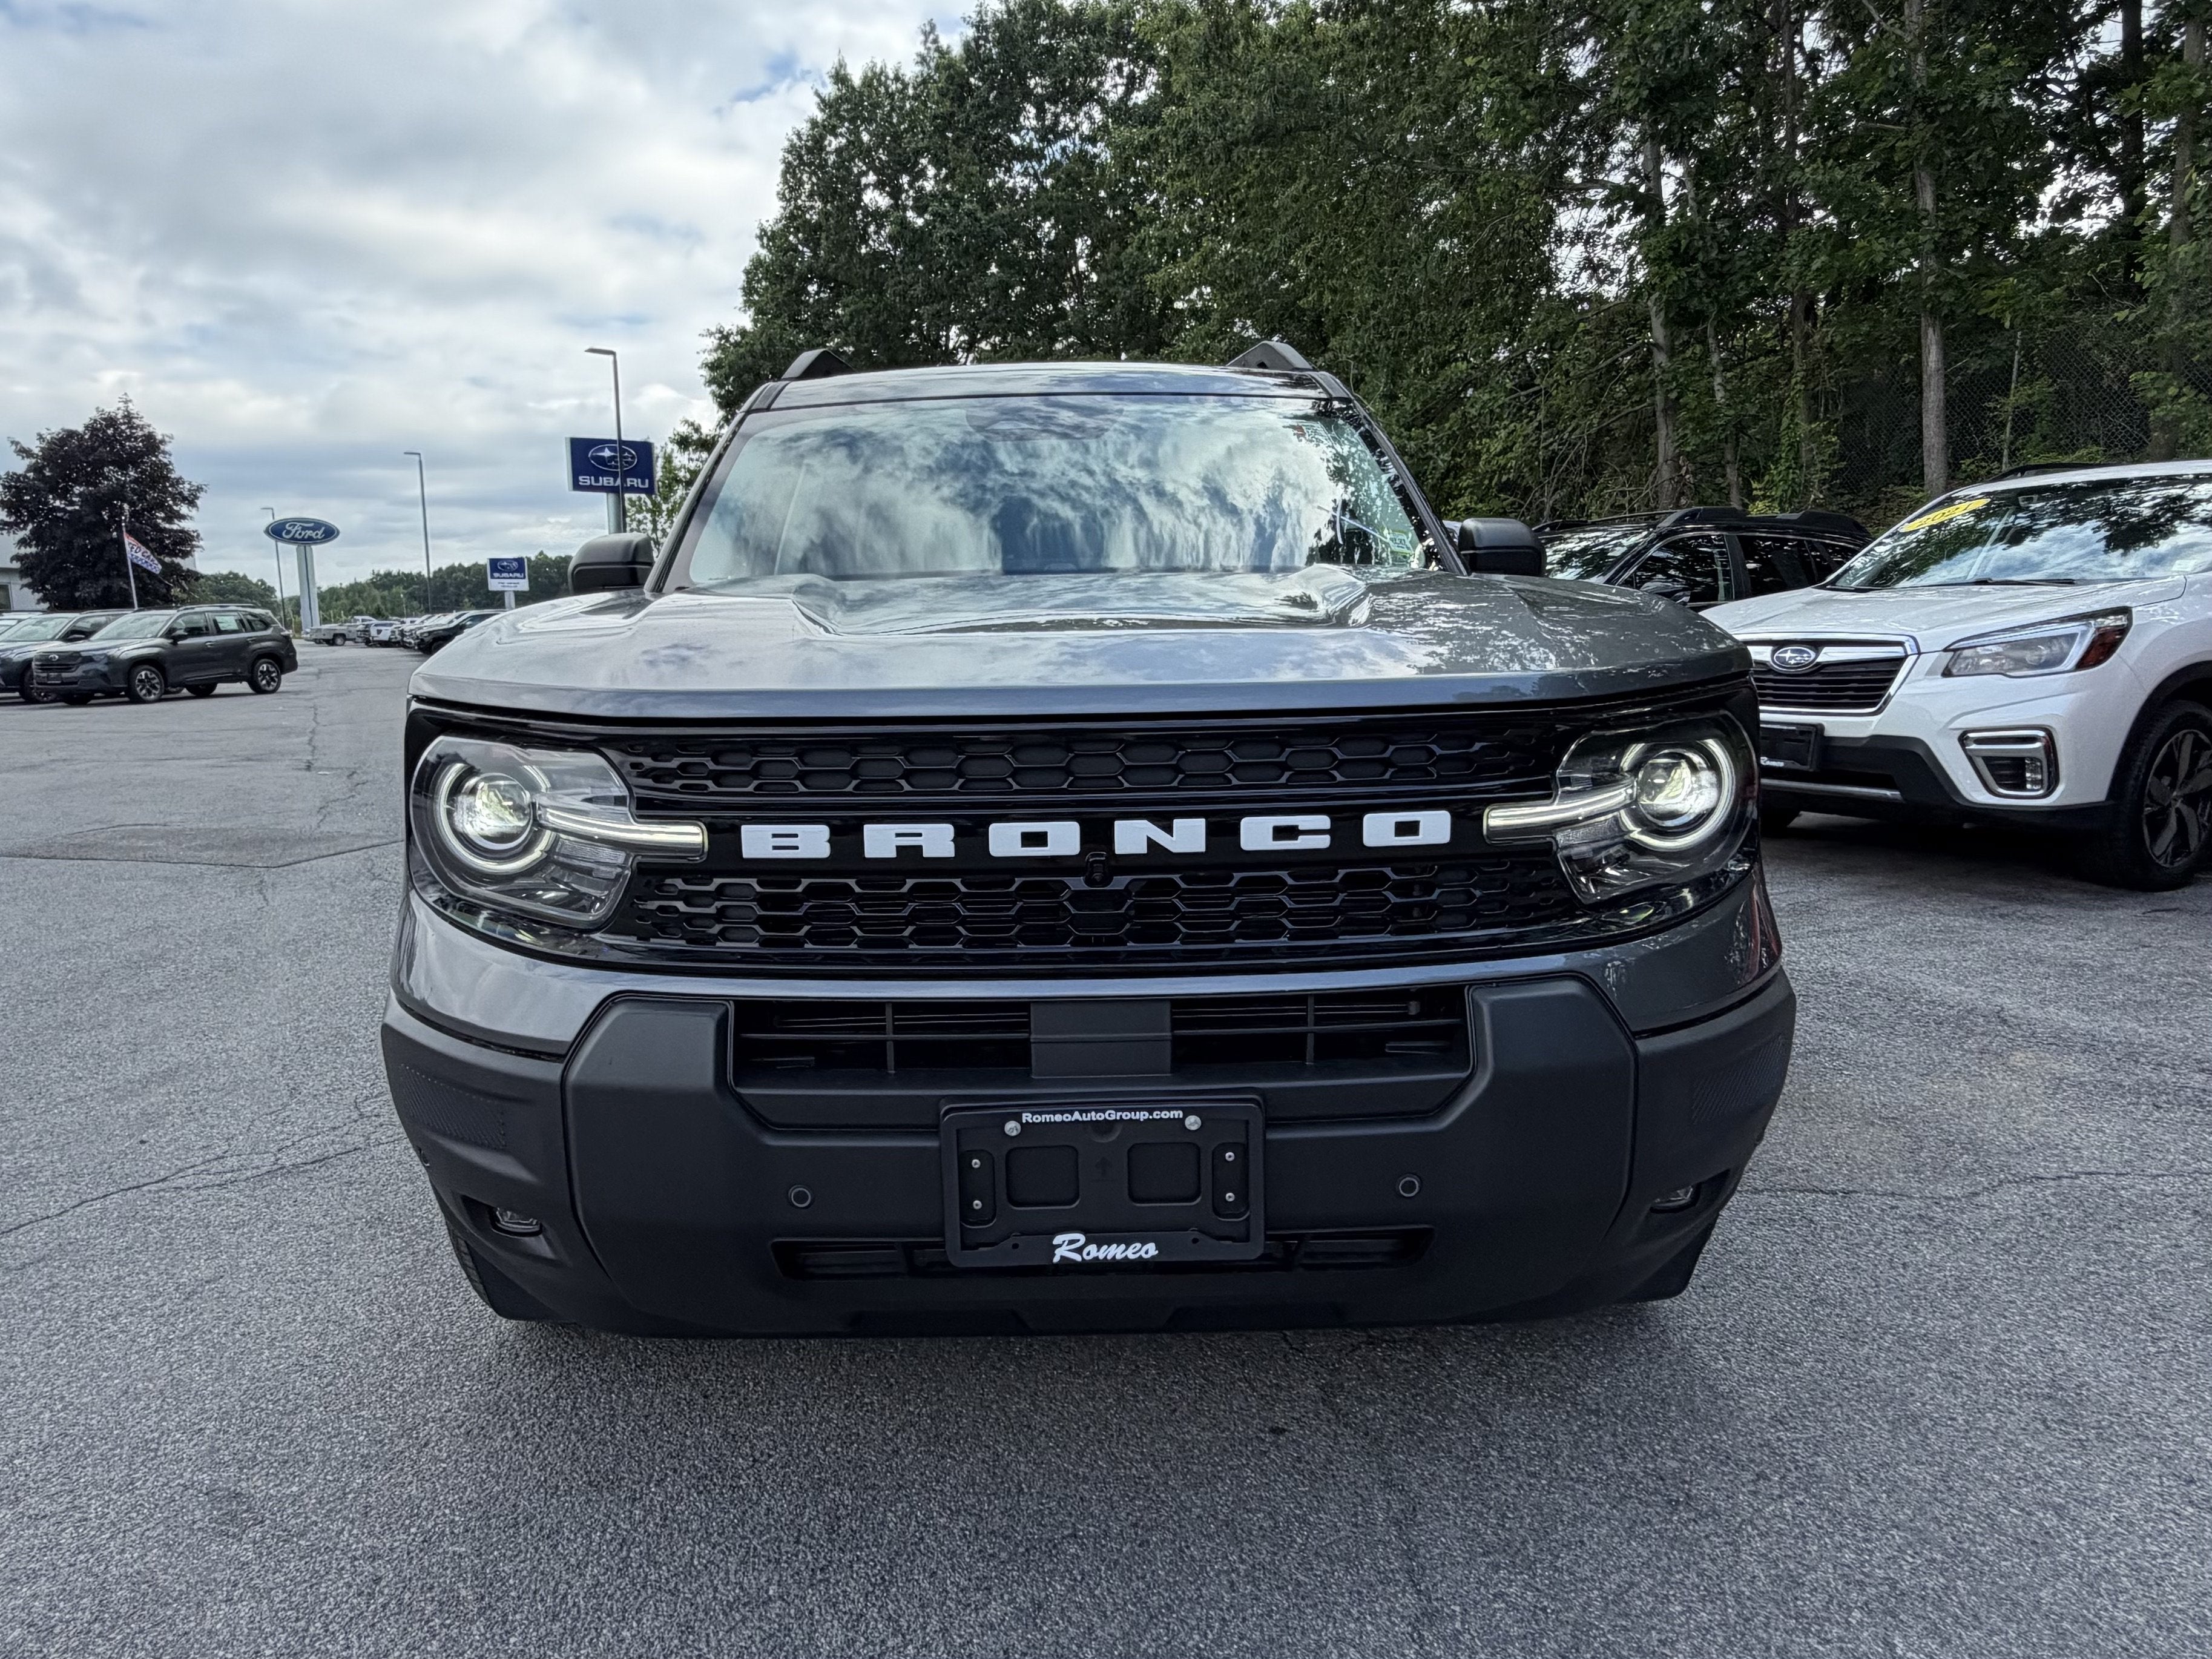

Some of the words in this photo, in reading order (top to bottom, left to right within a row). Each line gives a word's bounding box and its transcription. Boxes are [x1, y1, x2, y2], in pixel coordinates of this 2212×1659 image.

[282, 522, 325, 539] Ford
[740, 810, 1452, 859] BRONCO
[1022, 1110, 1183, 1123] RomeoAutoGroup.com
[1052, 1233, 1159, 1264] Romeo
